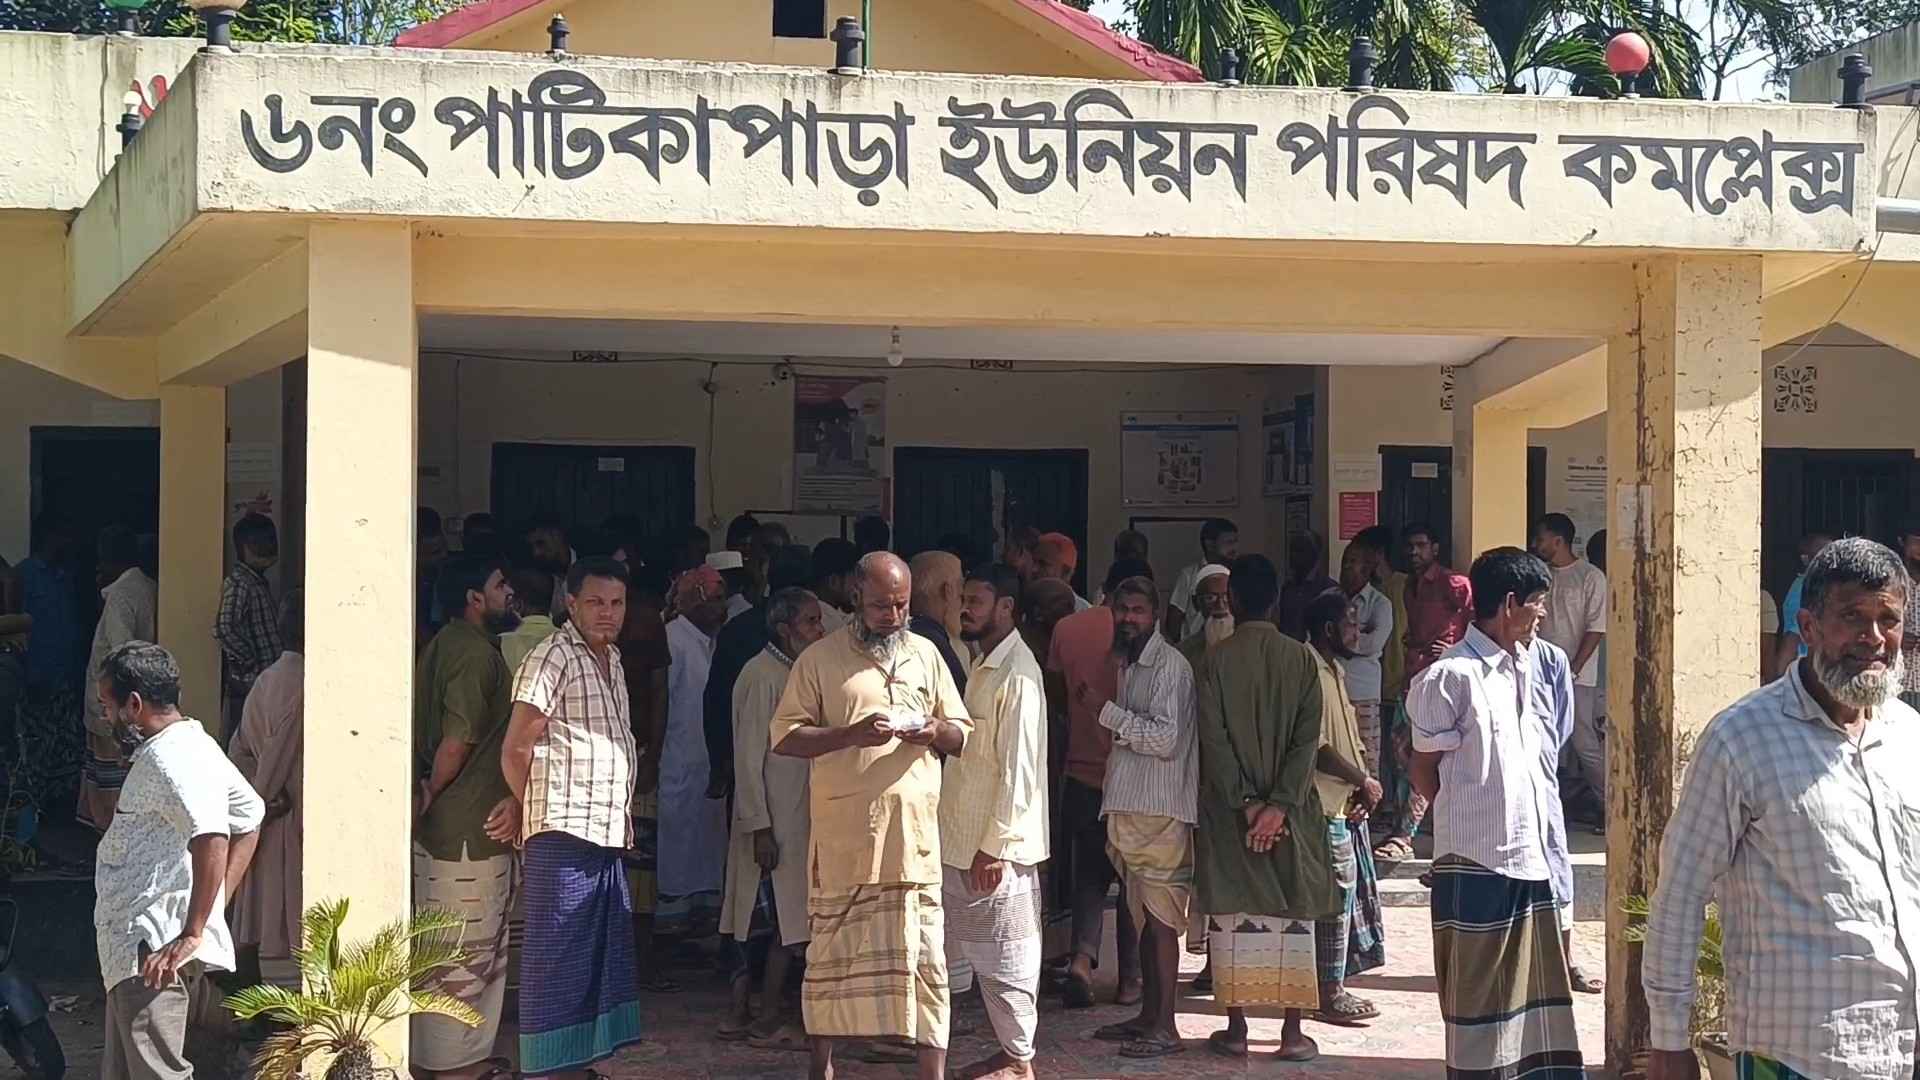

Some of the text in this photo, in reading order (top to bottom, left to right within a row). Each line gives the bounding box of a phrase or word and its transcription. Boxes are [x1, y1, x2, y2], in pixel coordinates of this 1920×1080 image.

[241, 70, 1865, 217] ৬নং পাটিকাপাড়া ইউনিয়ন পরিষদ কমপ্লেক্স
